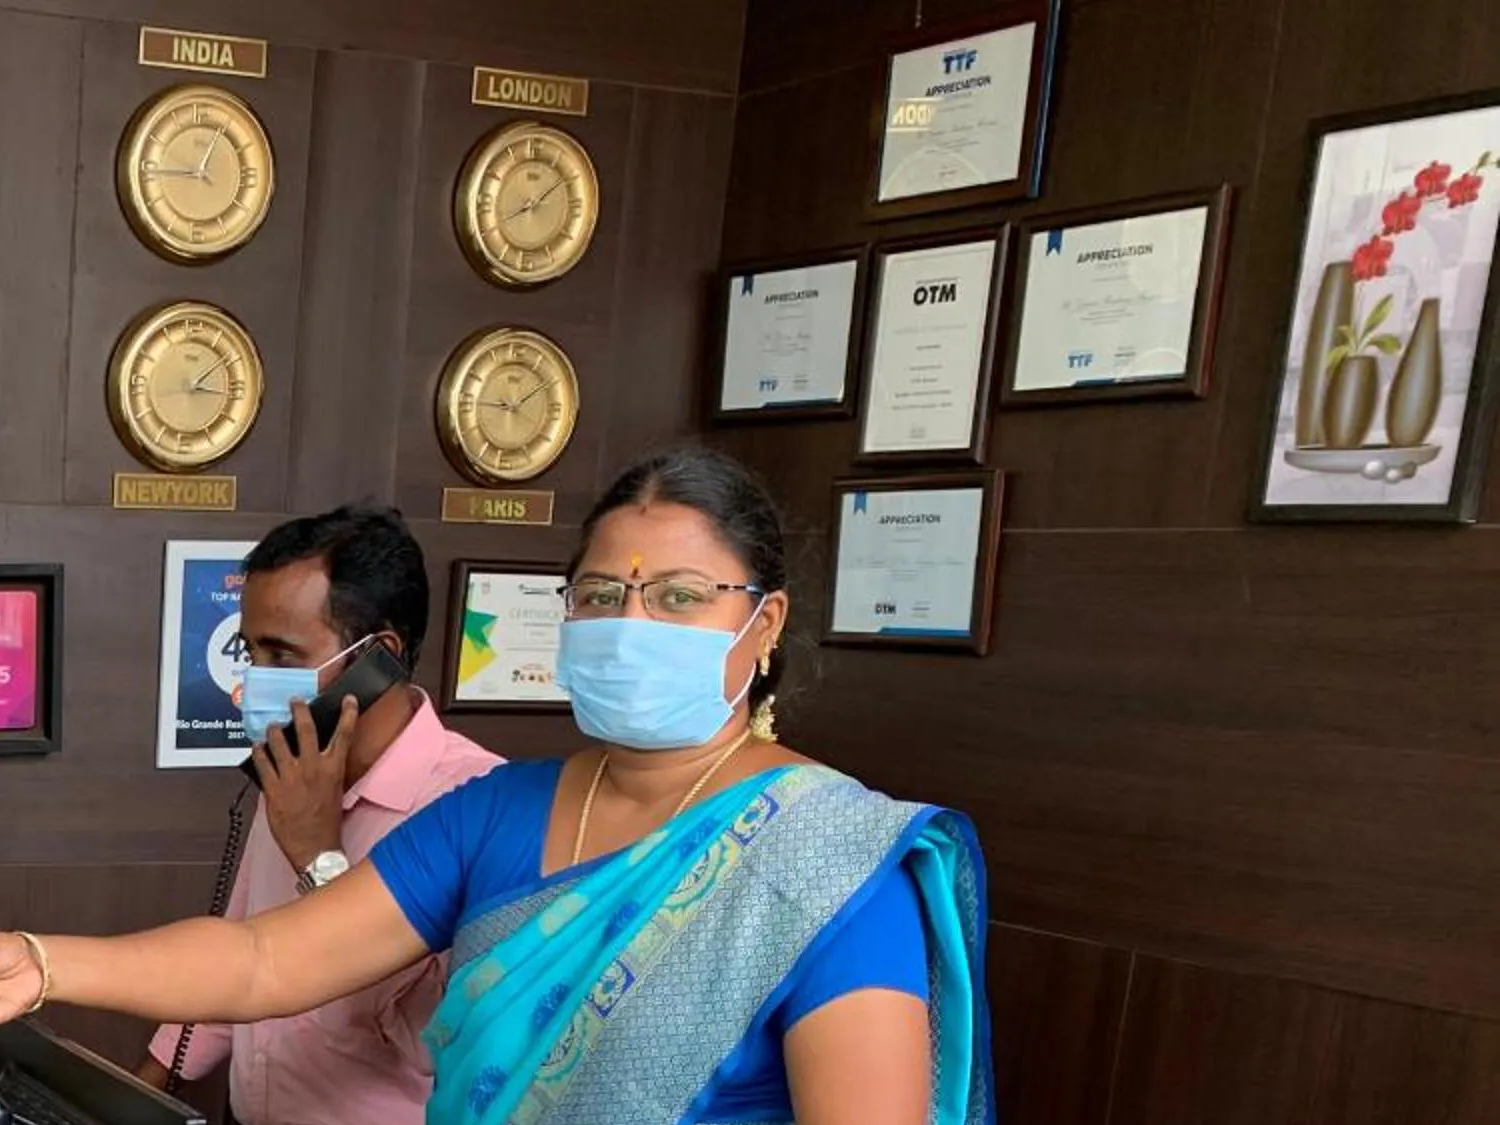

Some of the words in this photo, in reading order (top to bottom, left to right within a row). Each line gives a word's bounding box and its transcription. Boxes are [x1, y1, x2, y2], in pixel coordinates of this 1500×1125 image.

[172, 36, 235, 68] INDIA
[943, 49, 978, 74] TTF
[488, 75, 572, 108] LONDON
[925, 75, 992, 97] APPRECIATION
[1076, 243, 1154, 265] APPRECIATION
[912, 283, 958, 306] OTM
[1067, 353, 1094, 369] TTF
[121, 479, 230, 505] NEWYORK
